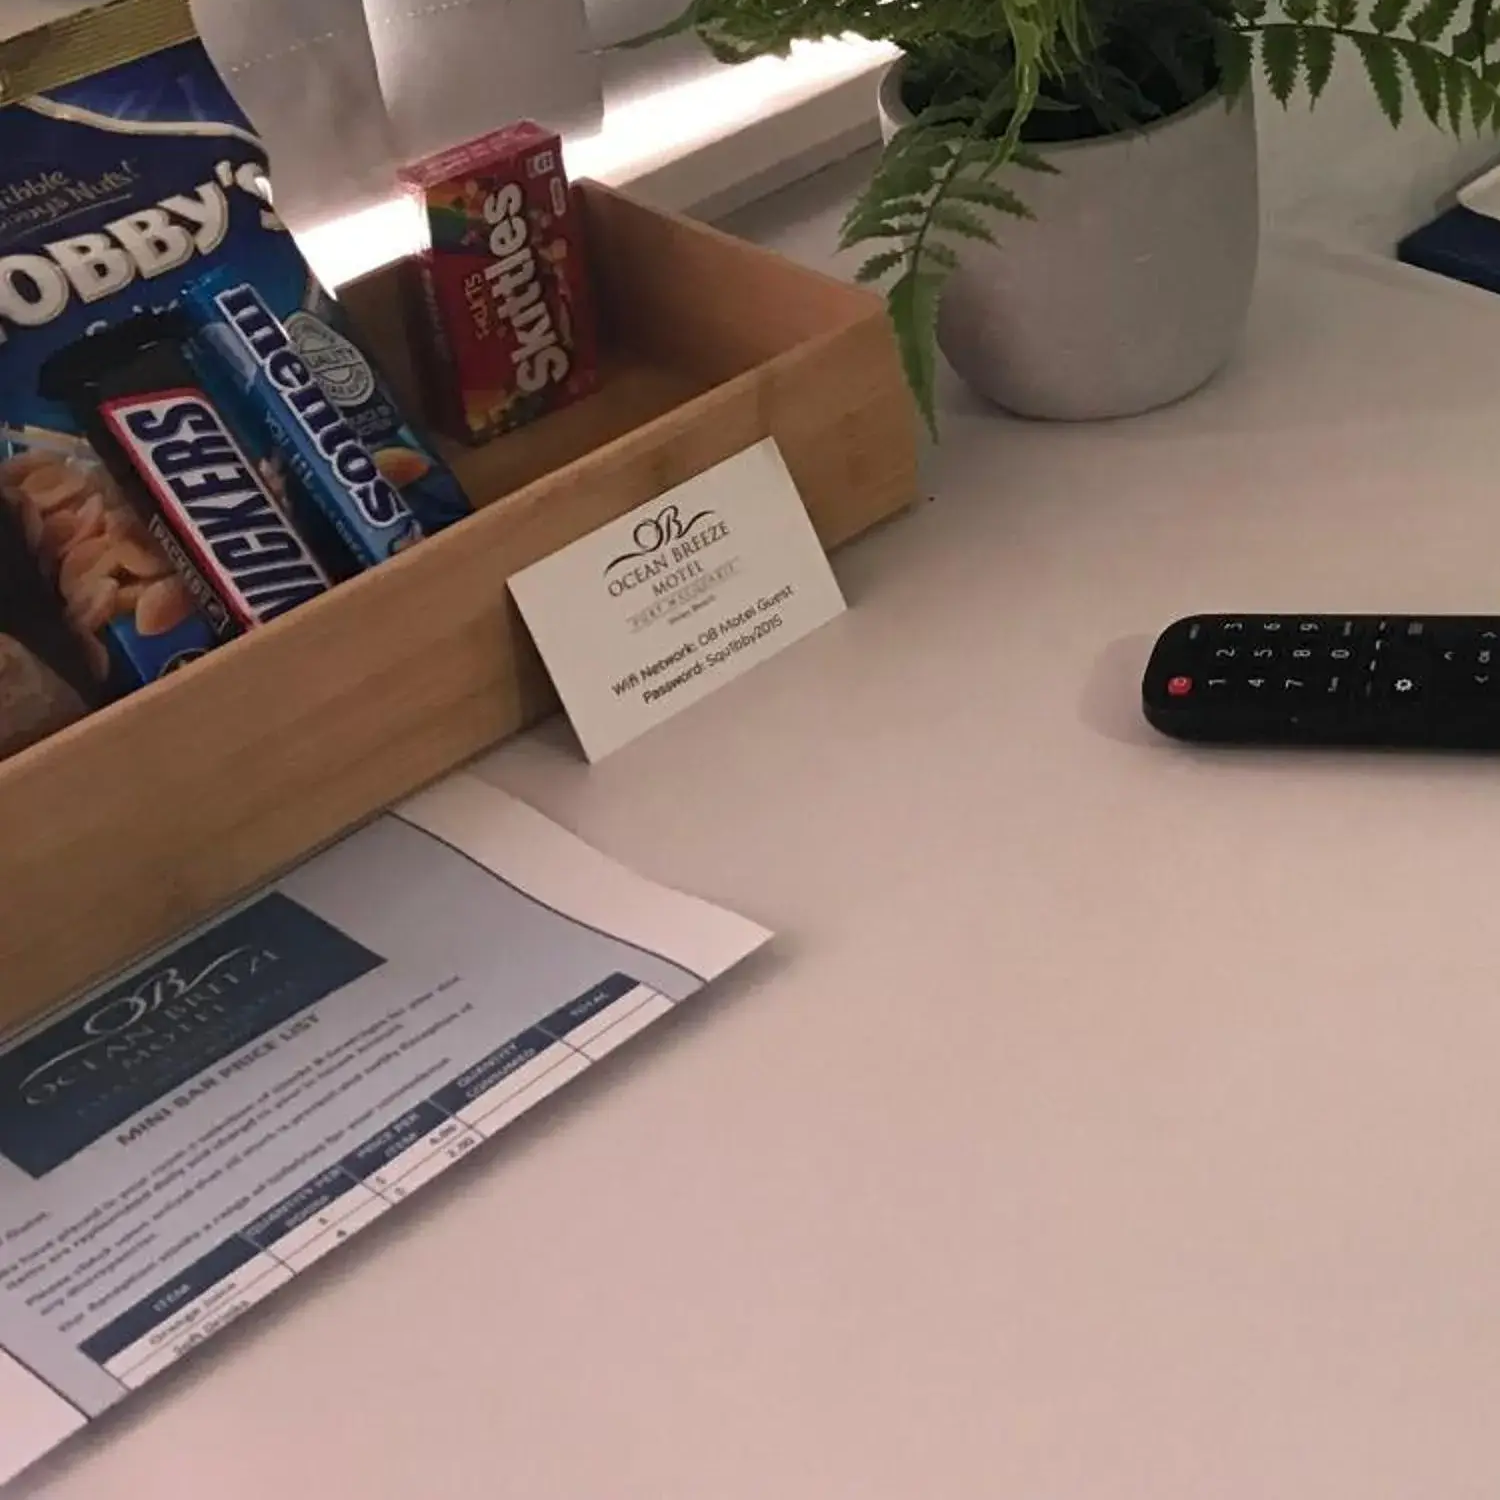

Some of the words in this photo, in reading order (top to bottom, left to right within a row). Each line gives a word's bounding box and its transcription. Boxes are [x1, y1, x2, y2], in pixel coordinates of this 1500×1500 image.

[0, 159, 289, 342] OBBY'S
[483, 182, 571, 393] Skittles
[216, 285, 409, 527] mentos
[126, 402, 329, 622] NICKERS
[607, 552, 669, 597] OCEAN
[671, 520, 730, 563] BREEZE
[652, 560, 704, 597] MOTEL
[698, 627, 719, 646] OB
[719, 607, 757, 634] Motel
[757, 583, 795, 611] Guest
[116, 1106, 173, 1147] MINI
[219, 1040, 278, 1080] PRICE
[279, 1013, 320, 1043] LIST
